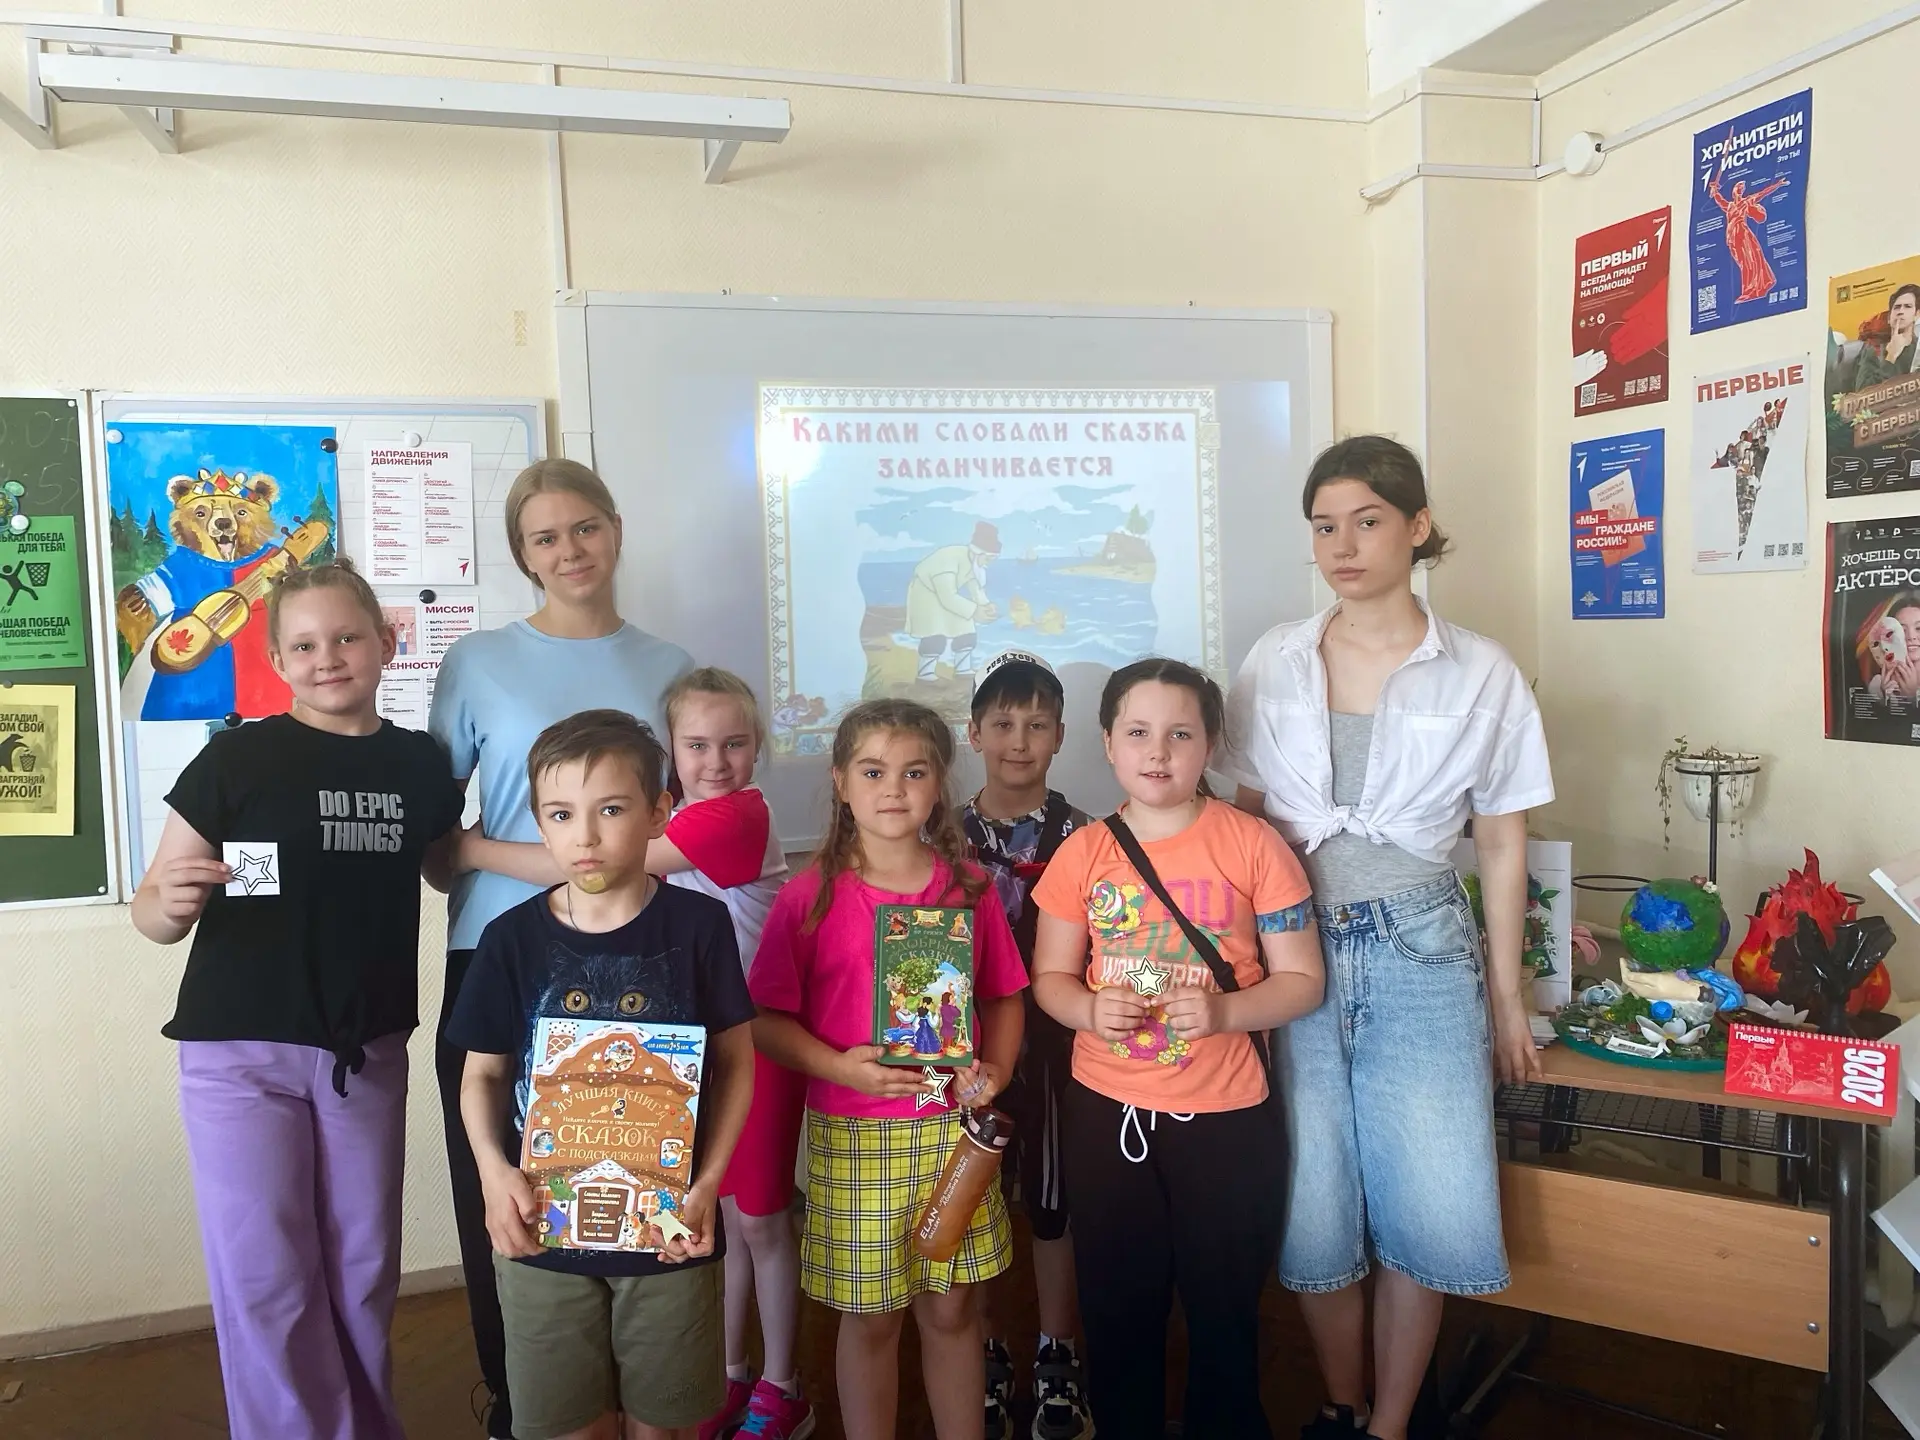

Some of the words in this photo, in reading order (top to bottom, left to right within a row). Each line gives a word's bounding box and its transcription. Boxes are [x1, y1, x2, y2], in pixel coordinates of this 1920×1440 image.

[1701, 111, 1803, 162] ХРАНИТЕЛИ
[1721, 130, 1803, 171] ИСТОРИИ
[1581, 239, 1649, 277] ПЕРВЫЙ
[1581, 273, 1612, 288] ВСЕГДА
[1613, 262, 1648, 278] ПРИДЕТ
[1580, 290, 1591, 298] НА
[1592, 276, 1635, 295] ПОМОЩЬ!
[1697, 365, 1804, 403] ПЕРВЫЕ
[1860, 425, 1869, 439] С
[371, 450, 449, 459] НАПРАВЛЕНИЯ
[371, 458, 433, 466] ДВИЖЕНИЯ
[1595, 520, 1655, 536] ГРАЖДАНЕ
[28, 533, 65, 542] ПОБЕДА
[1576, 536, 1627, 549] РОССИИ!»
[18, 543, 38, 554] ДЛЯ
[39, 542, 66, 552] ТЕБЯ!
[1842, 549, 1901, 567] ХОЧЕШЬ
[425, 606, 474, 614] МИССИЯ
[29, 617, 70, 628] ПОБЕДА
[0, 714, 38, 722] ЗАГАДИЛ
[18, 721, 44, 733] СВОЙ
[319, 790, 350, 817] DO
[355, 792, 404, 819] EPIC
[320, 821, 404, 853] THINGS
[1736, 1031, 1775, 1044] Первые
[1841, 1048, 1887, 1108] 2026
[557, 1086, 618, 1114] ЛУЧШАЯ
[623, 1088, 669, 1121] КНИГА
[557, 1124, 660, 1148] СКАЗОК
[557, 1148, 566, 1158] С
[569, 1149, 658, 1162] ПОДСКАЗКАМИ
[920, 1207, 939, 1240] ELAN
